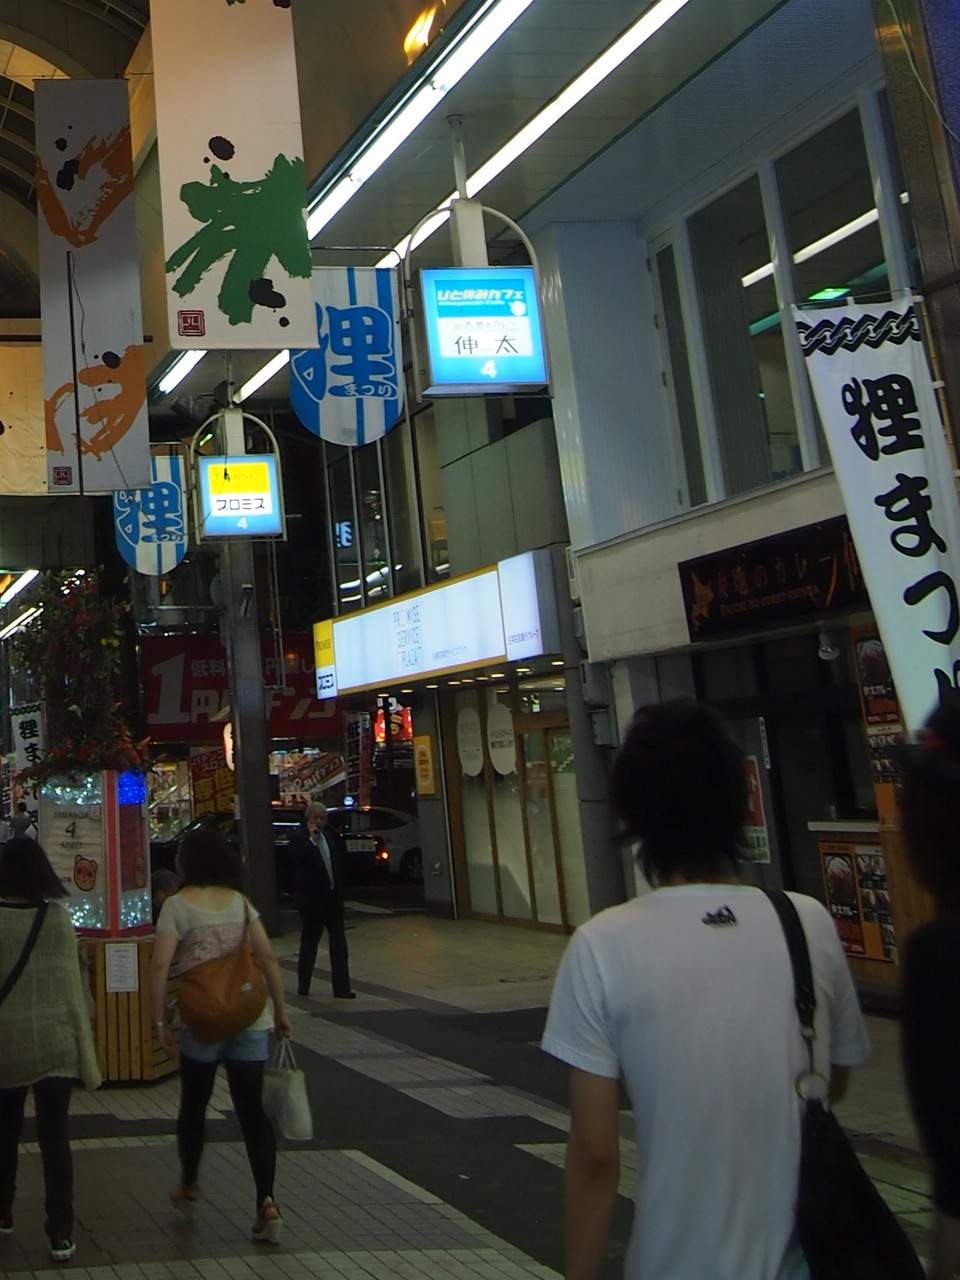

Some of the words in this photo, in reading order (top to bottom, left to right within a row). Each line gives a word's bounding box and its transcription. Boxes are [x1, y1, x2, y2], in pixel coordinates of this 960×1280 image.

[480, 360, 497, 378] 4
[215, 498, 266, 511] プロミス
